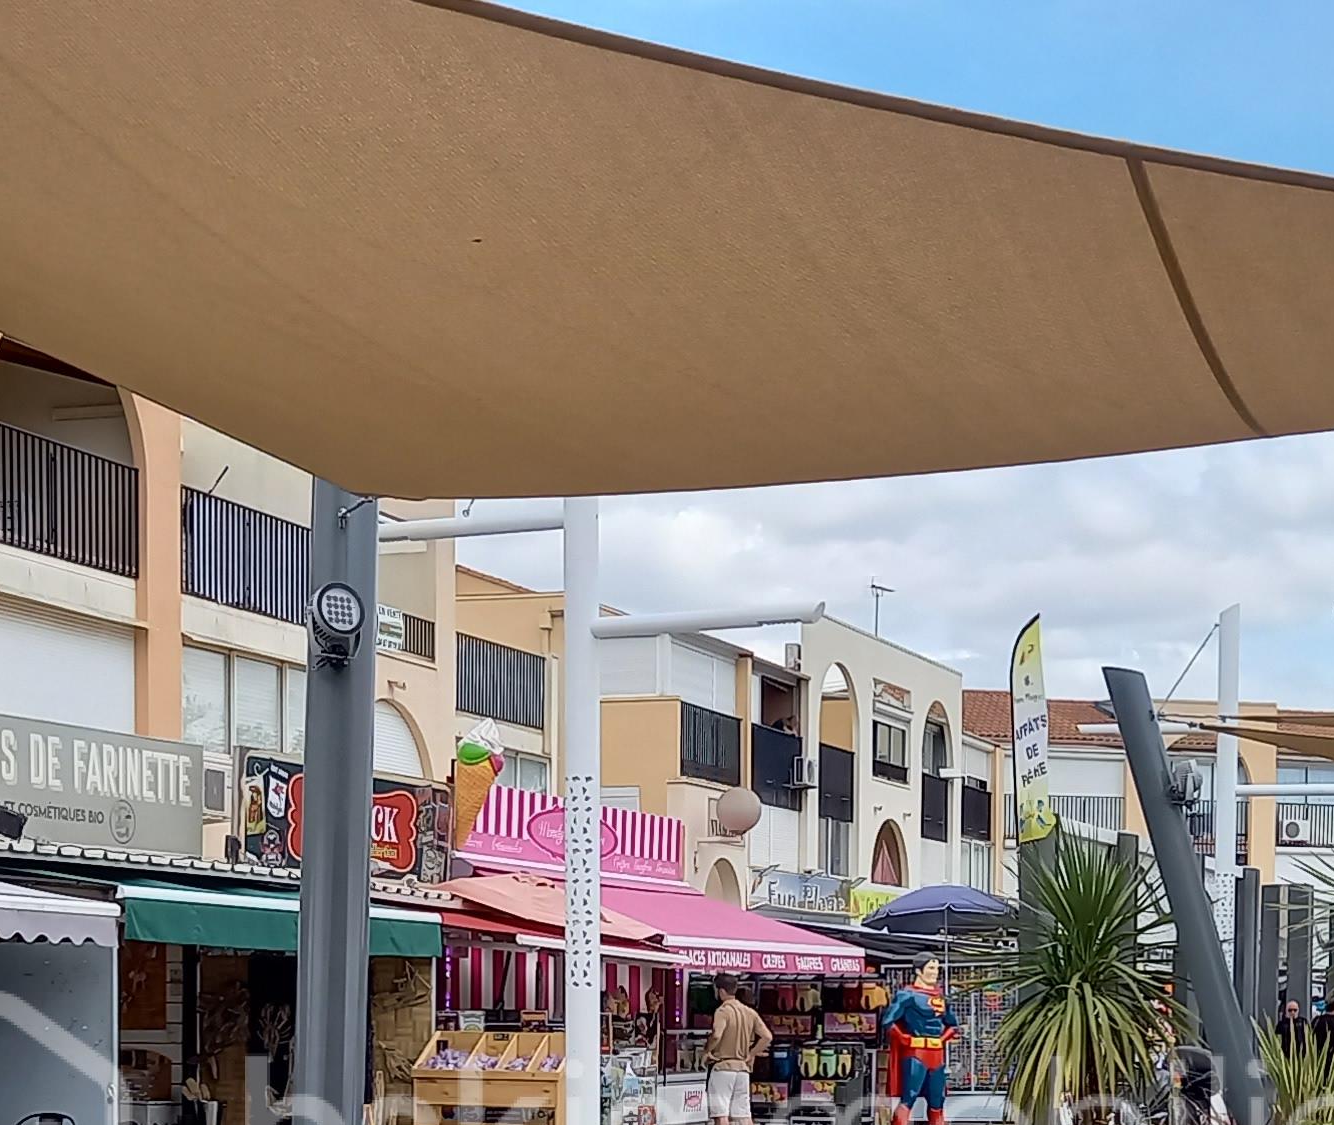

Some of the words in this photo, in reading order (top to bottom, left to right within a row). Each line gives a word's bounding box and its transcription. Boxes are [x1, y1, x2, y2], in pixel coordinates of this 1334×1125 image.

[1026, 744, 1039, 760] DE
[29, 733, 64, 793] DE
[73, 740, 193, 807] FARINETTE
[18, 802, 86, 823] COSMÉTIQUES
[89, 811, 105, 825] BIO
